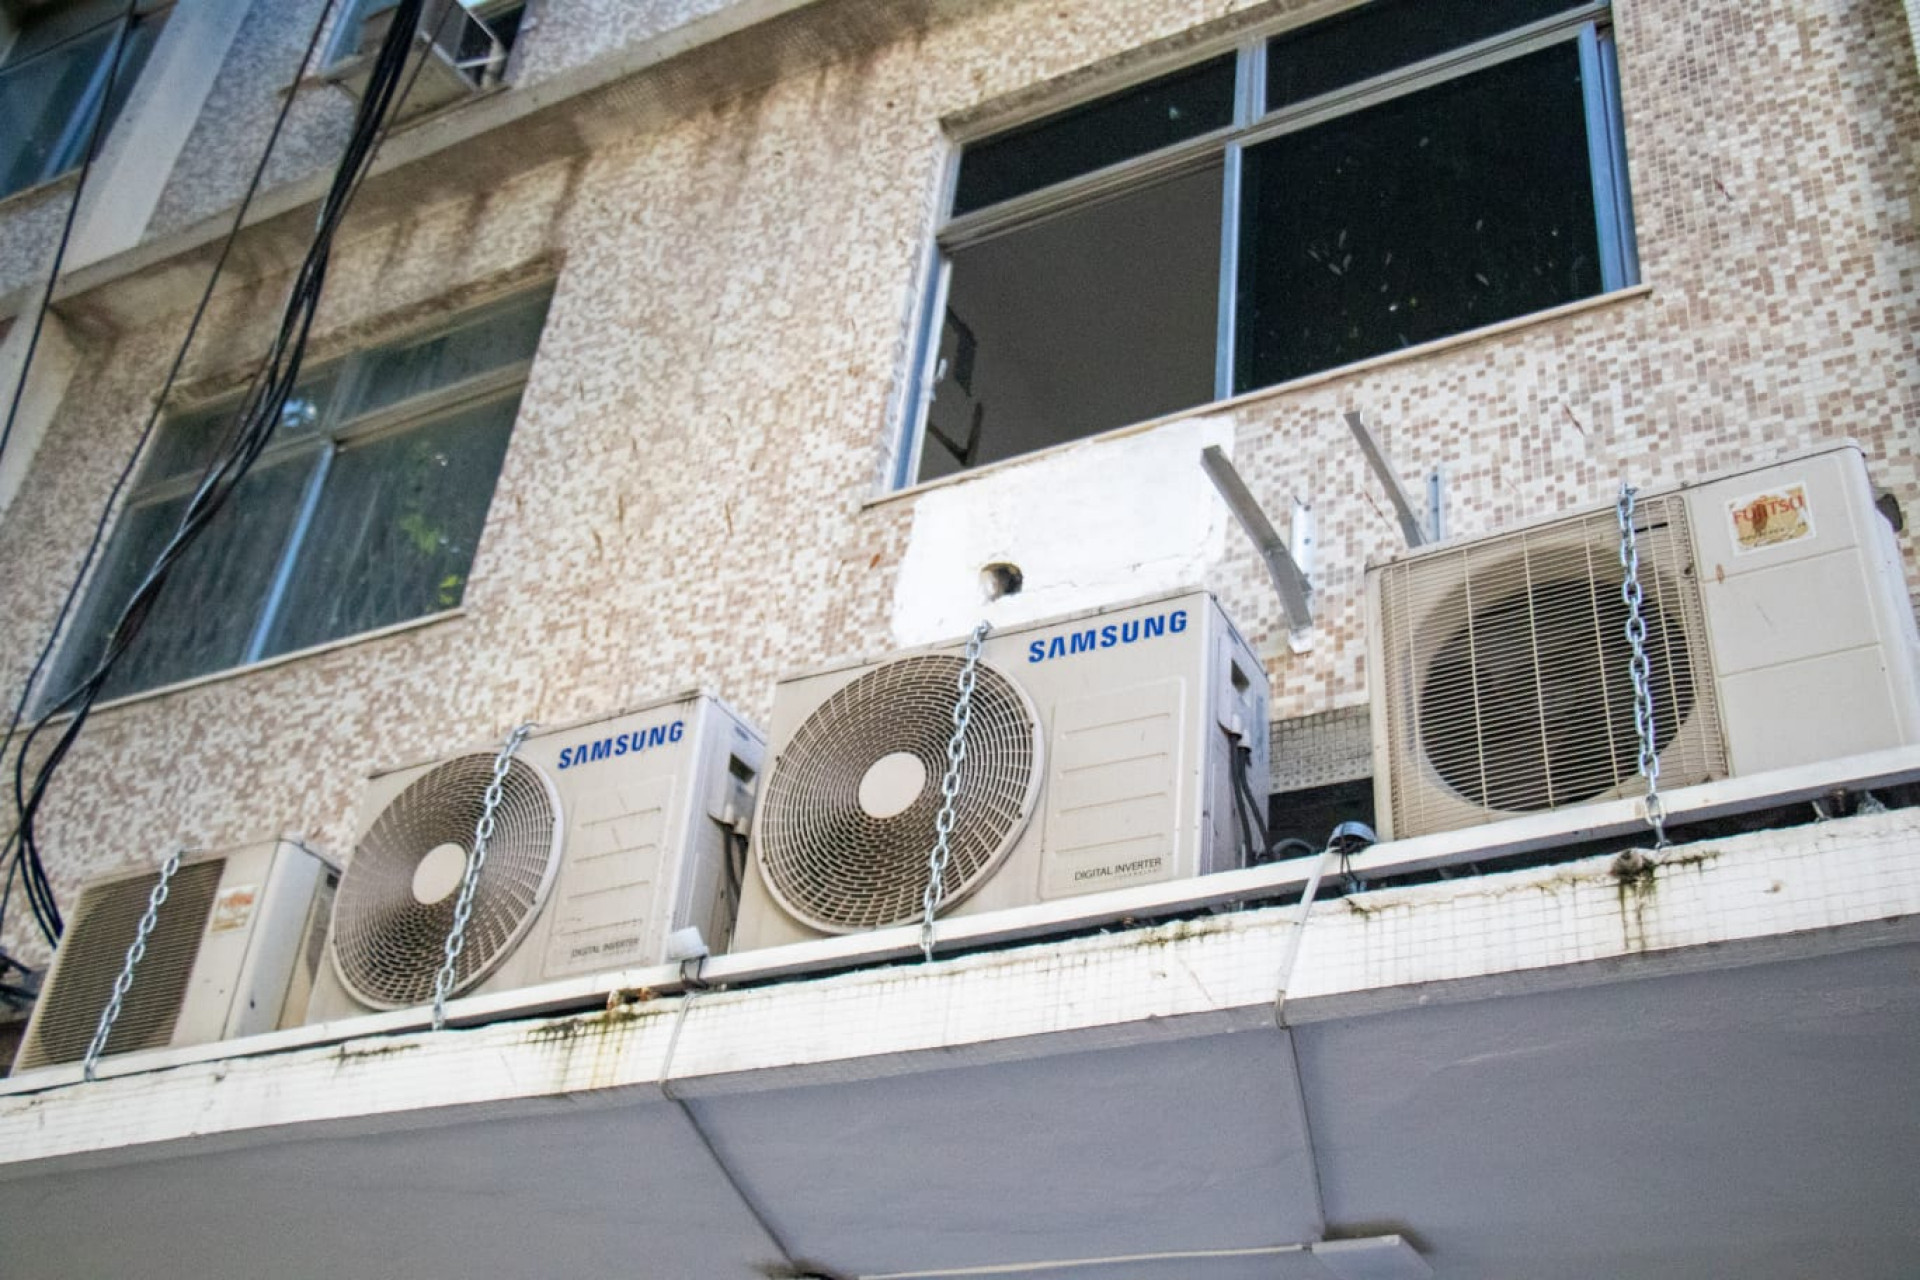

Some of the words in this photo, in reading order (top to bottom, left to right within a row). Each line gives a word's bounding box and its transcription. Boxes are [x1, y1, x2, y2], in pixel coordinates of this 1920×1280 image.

[1028, 610, 1188, 663] SAMSUNG
[557, 720, 685, 770] SAMSUNG
[1074, 866, 1113, 881] DIGITAL
[1114, 857, 1162, 874] INVERTER
